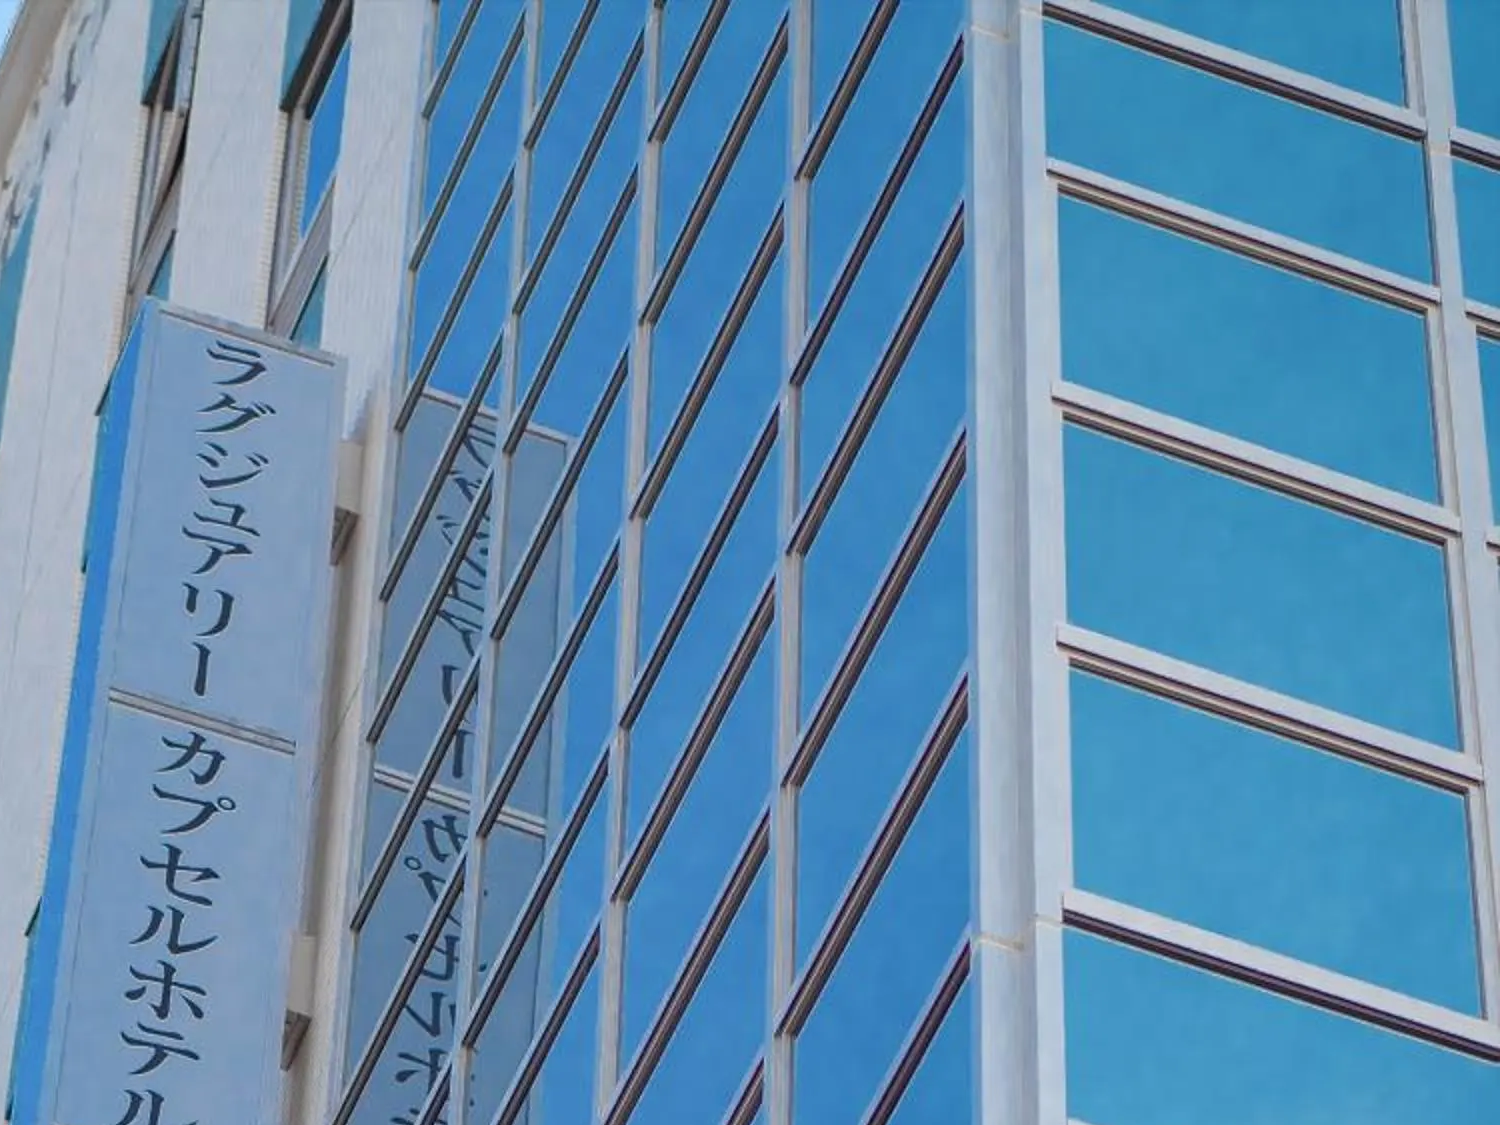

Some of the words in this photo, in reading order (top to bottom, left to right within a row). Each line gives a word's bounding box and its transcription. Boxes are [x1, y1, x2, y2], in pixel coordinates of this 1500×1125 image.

[181, 339, 277, 697] ラグジュアリー
